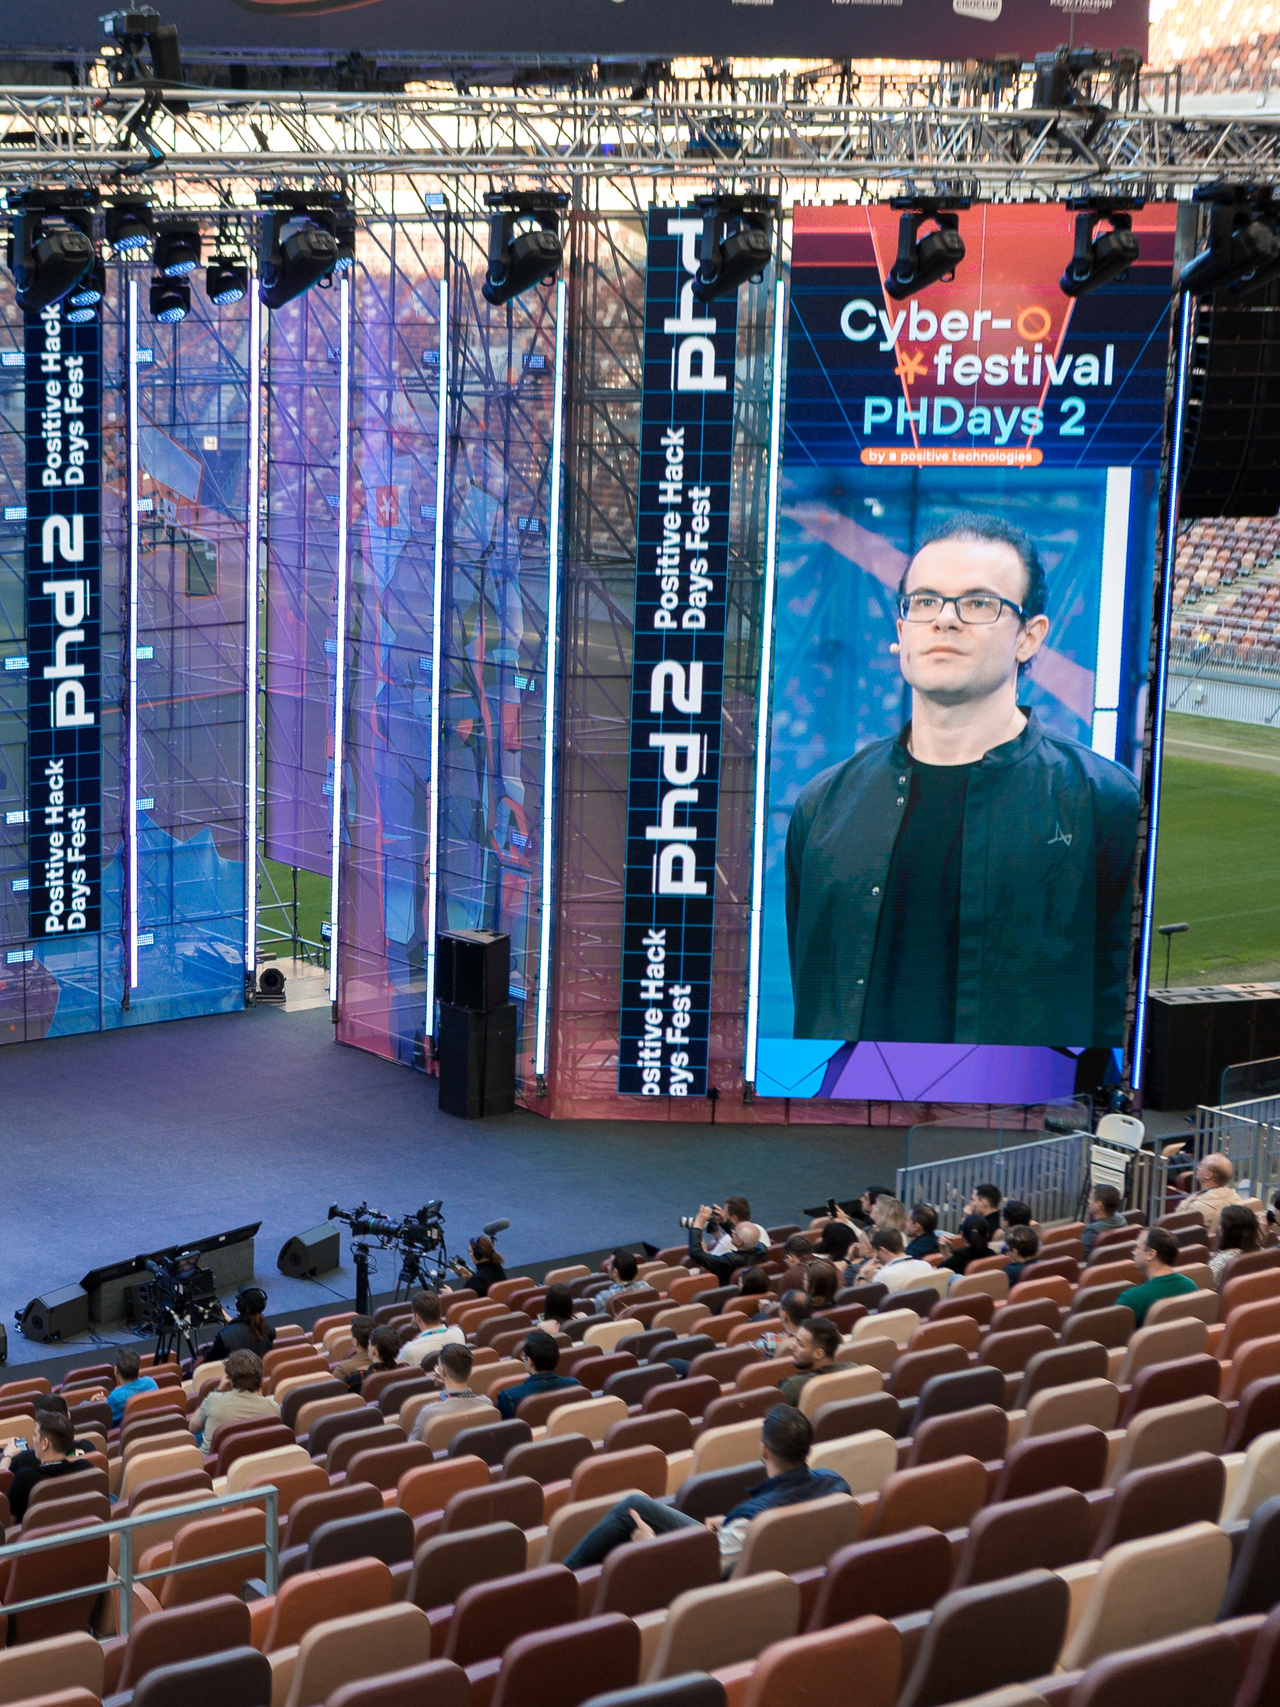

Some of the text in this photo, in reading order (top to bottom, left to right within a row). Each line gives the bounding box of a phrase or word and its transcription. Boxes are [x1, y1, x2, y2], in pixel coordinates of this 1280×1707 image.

[840, 299, 1011, 351] Cyber-
[933, 343, 1114, 386] festival
[40, 303, 62, 487] Positive Hack
[64, 355, 89, 486] Days Fest
[863, 396, 1086, 445] PHDays 2
[869, 450, 1032, 464] by positive technologies
[654, 426, 685, 630] Positive Hack
[682, 485, 713, 630] Days Fest
[42, 514, 95, 728] phd 2
[645, 660, 708, 896] phd 2
[44, 758, 65, 933] Positive Hack
[67, 807, 91, 931] Days Fest
[640, 928, 666, 1000] Hack
[665, 984, 692, 1044] Fest
